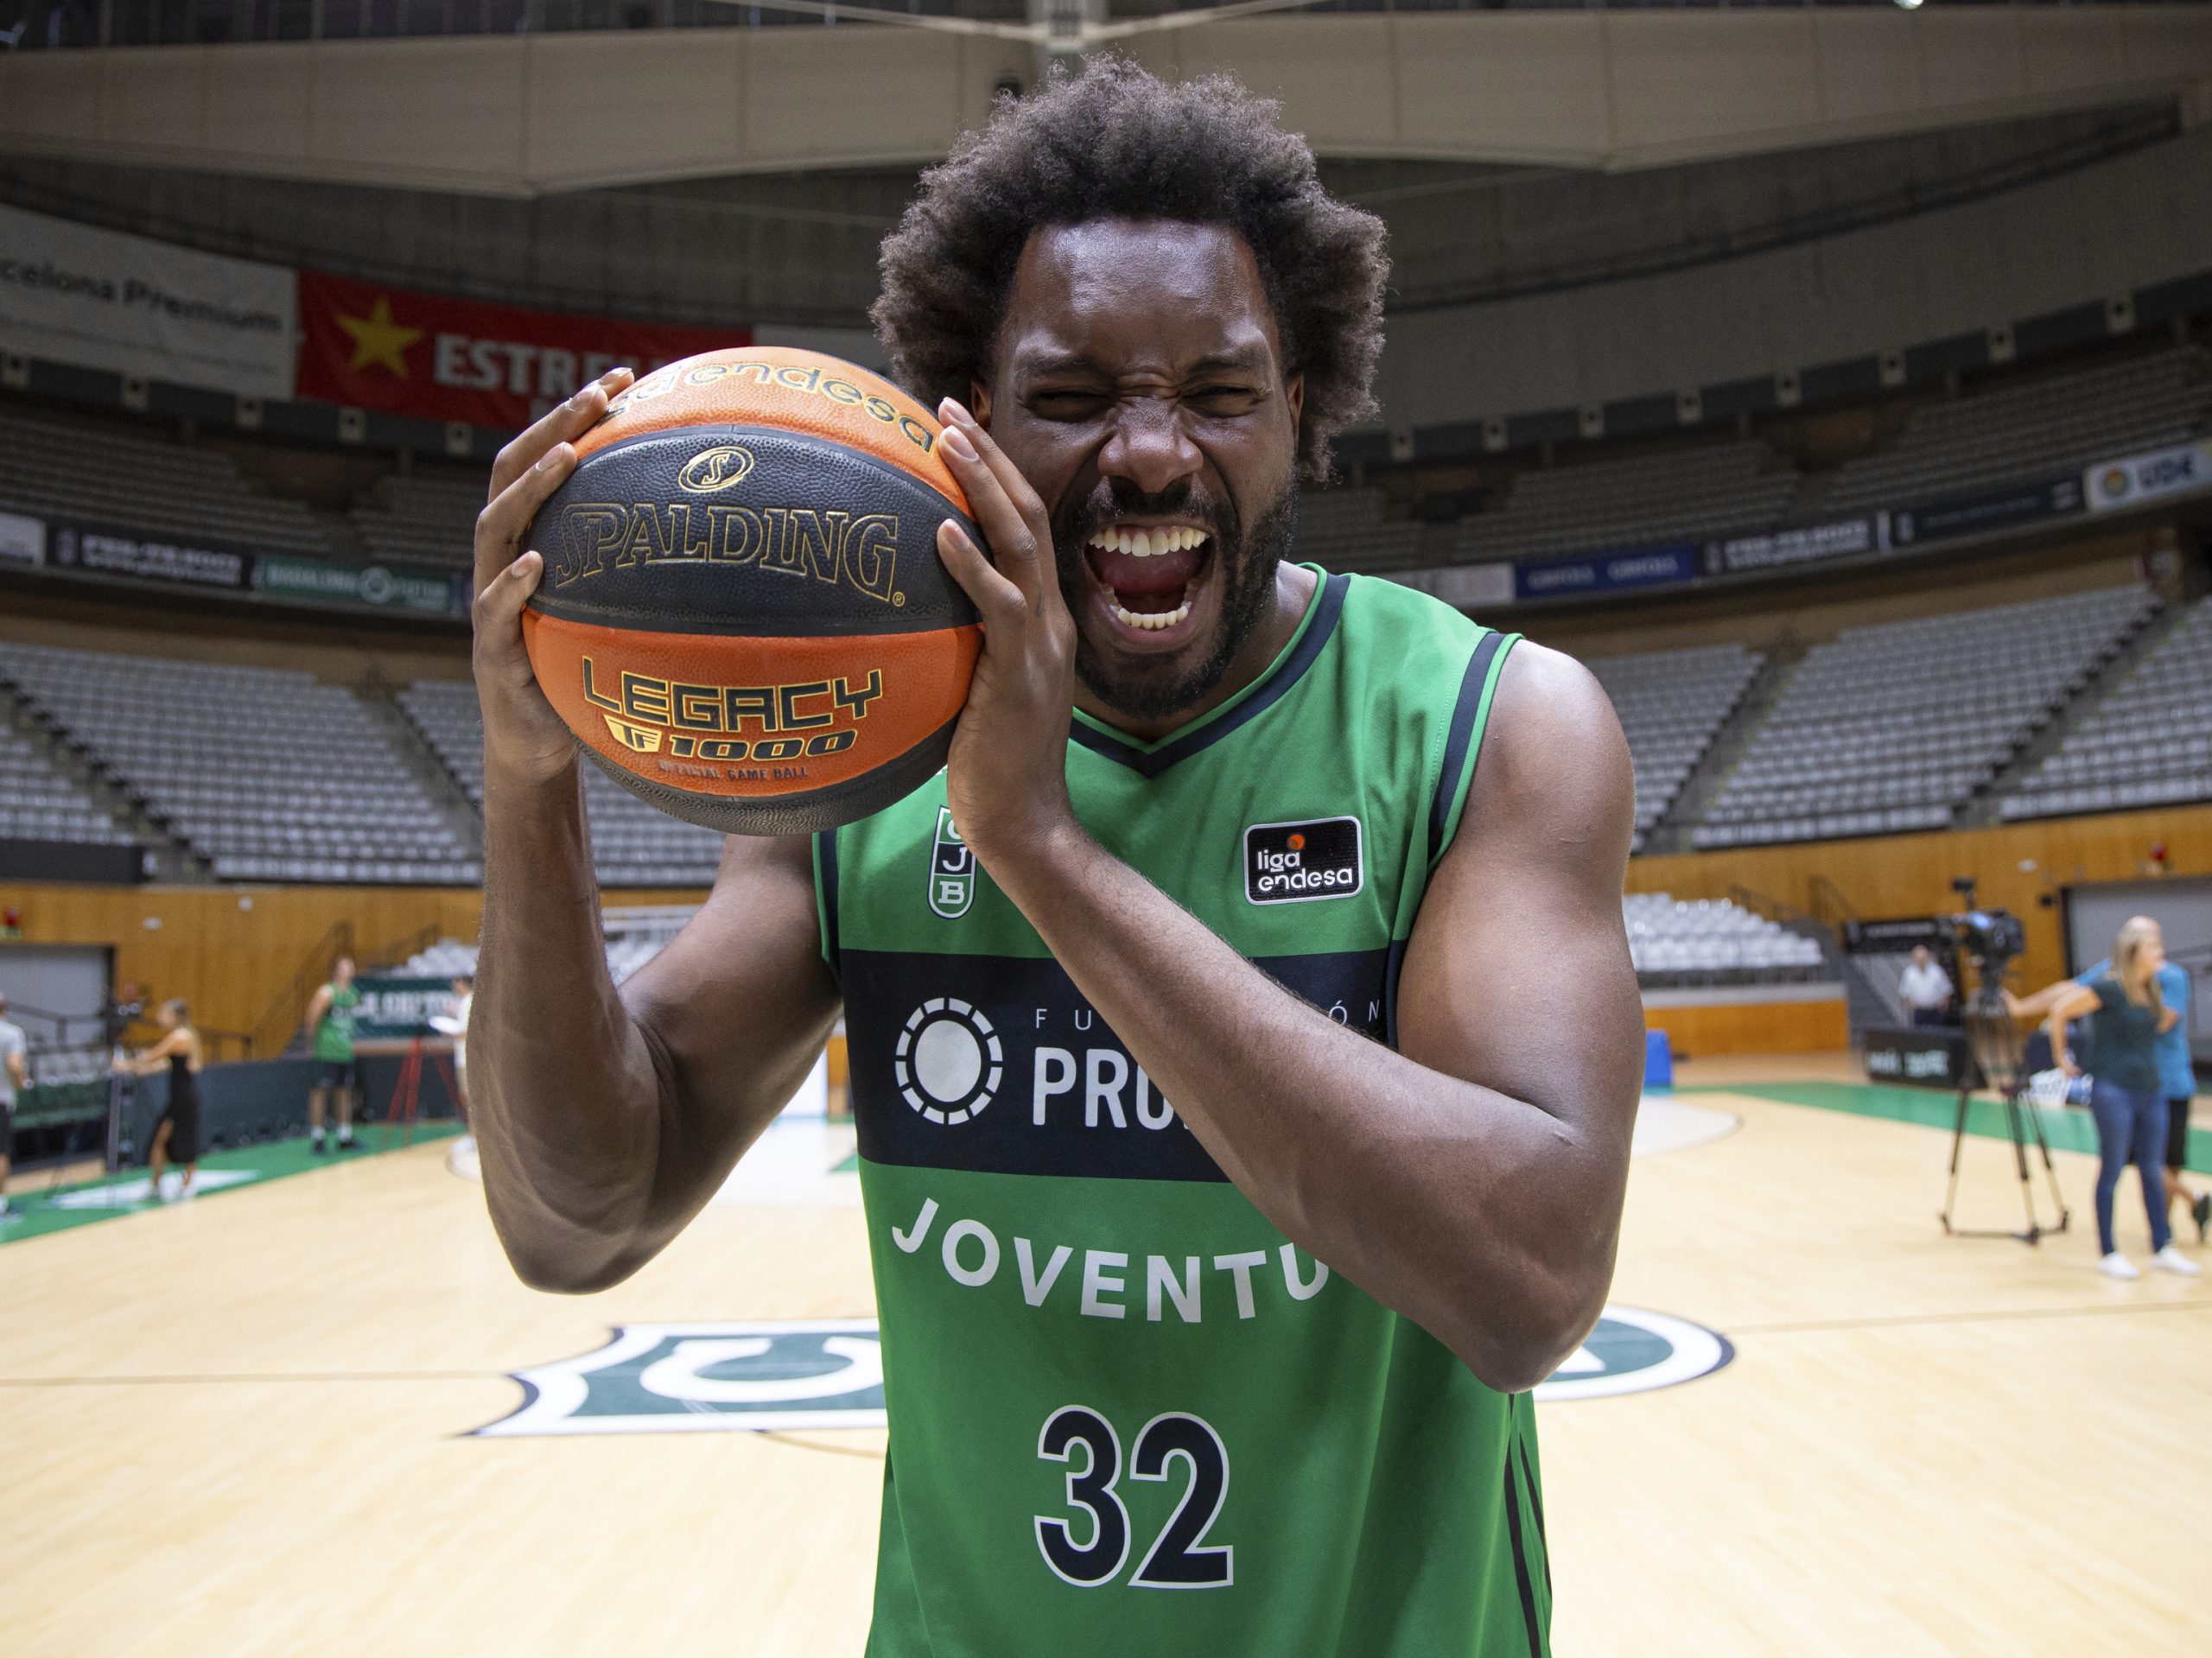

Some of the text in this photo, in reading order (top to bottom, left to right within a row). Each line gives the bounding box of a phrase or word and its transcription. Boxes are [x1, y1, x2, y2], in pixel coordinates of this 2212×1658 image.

[434, 334, 664, 399] ESTRE
[683, 361, 936, 455] endesa
[582, 656, 883, 733] LEGACY
[669, 728, 858, 761] 1000
[657, 759, 809, 780] OFFICIAL GAME BALL
[1257, 849, 1300, 873] liga
[1258, 867, 1353, 892] endesa
[1034, 1404, 1234, 1589] 32
